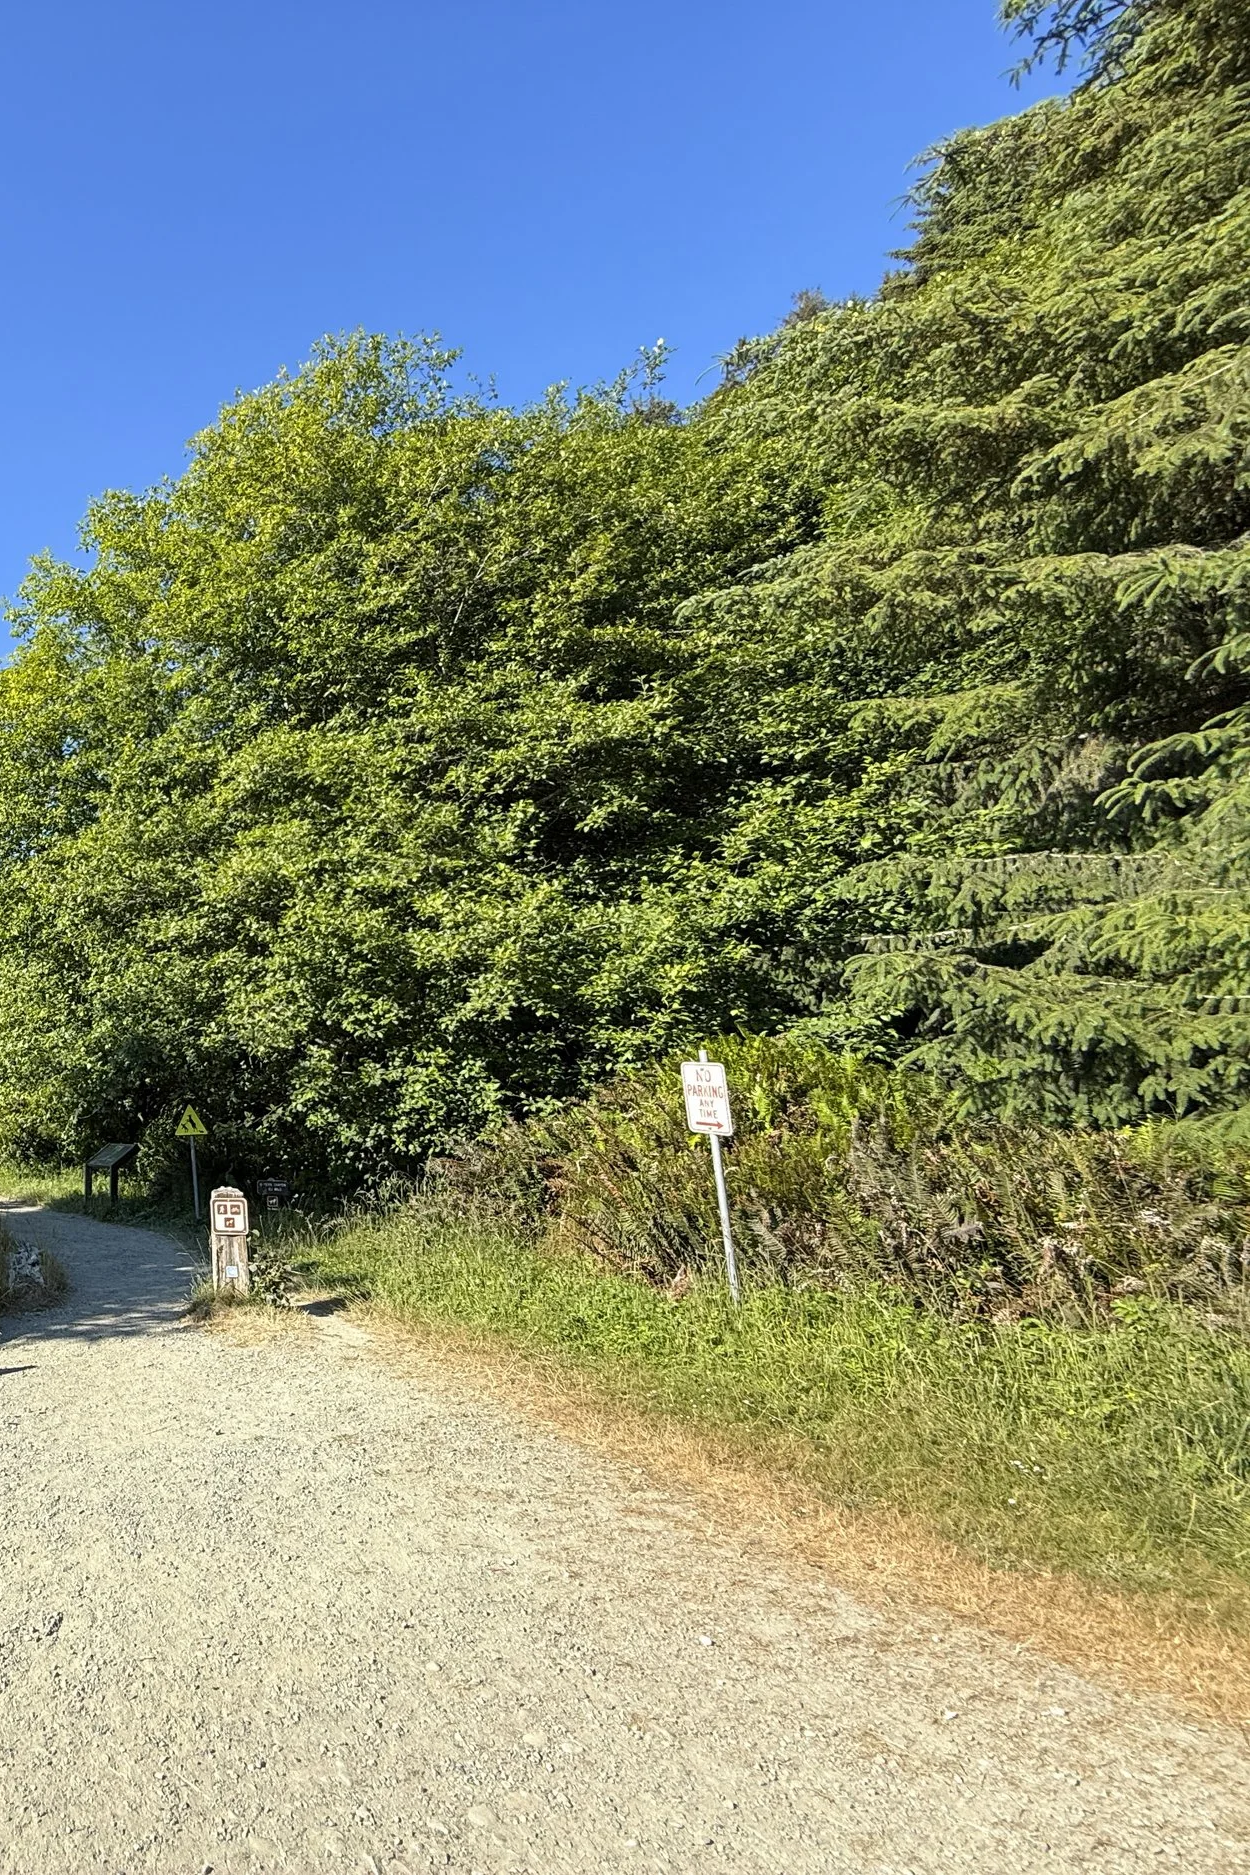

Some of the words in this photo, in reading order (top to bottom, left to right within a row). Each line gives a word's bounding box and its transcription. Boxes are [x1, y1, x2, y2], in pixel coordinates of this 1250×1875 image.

[696, 1070, 711, 1082] NO
[687, 1084, 724, 1098] PARKING
[700, 1099, 714, 1107] ANY
[698, 1108, 718, 1119] TIME
